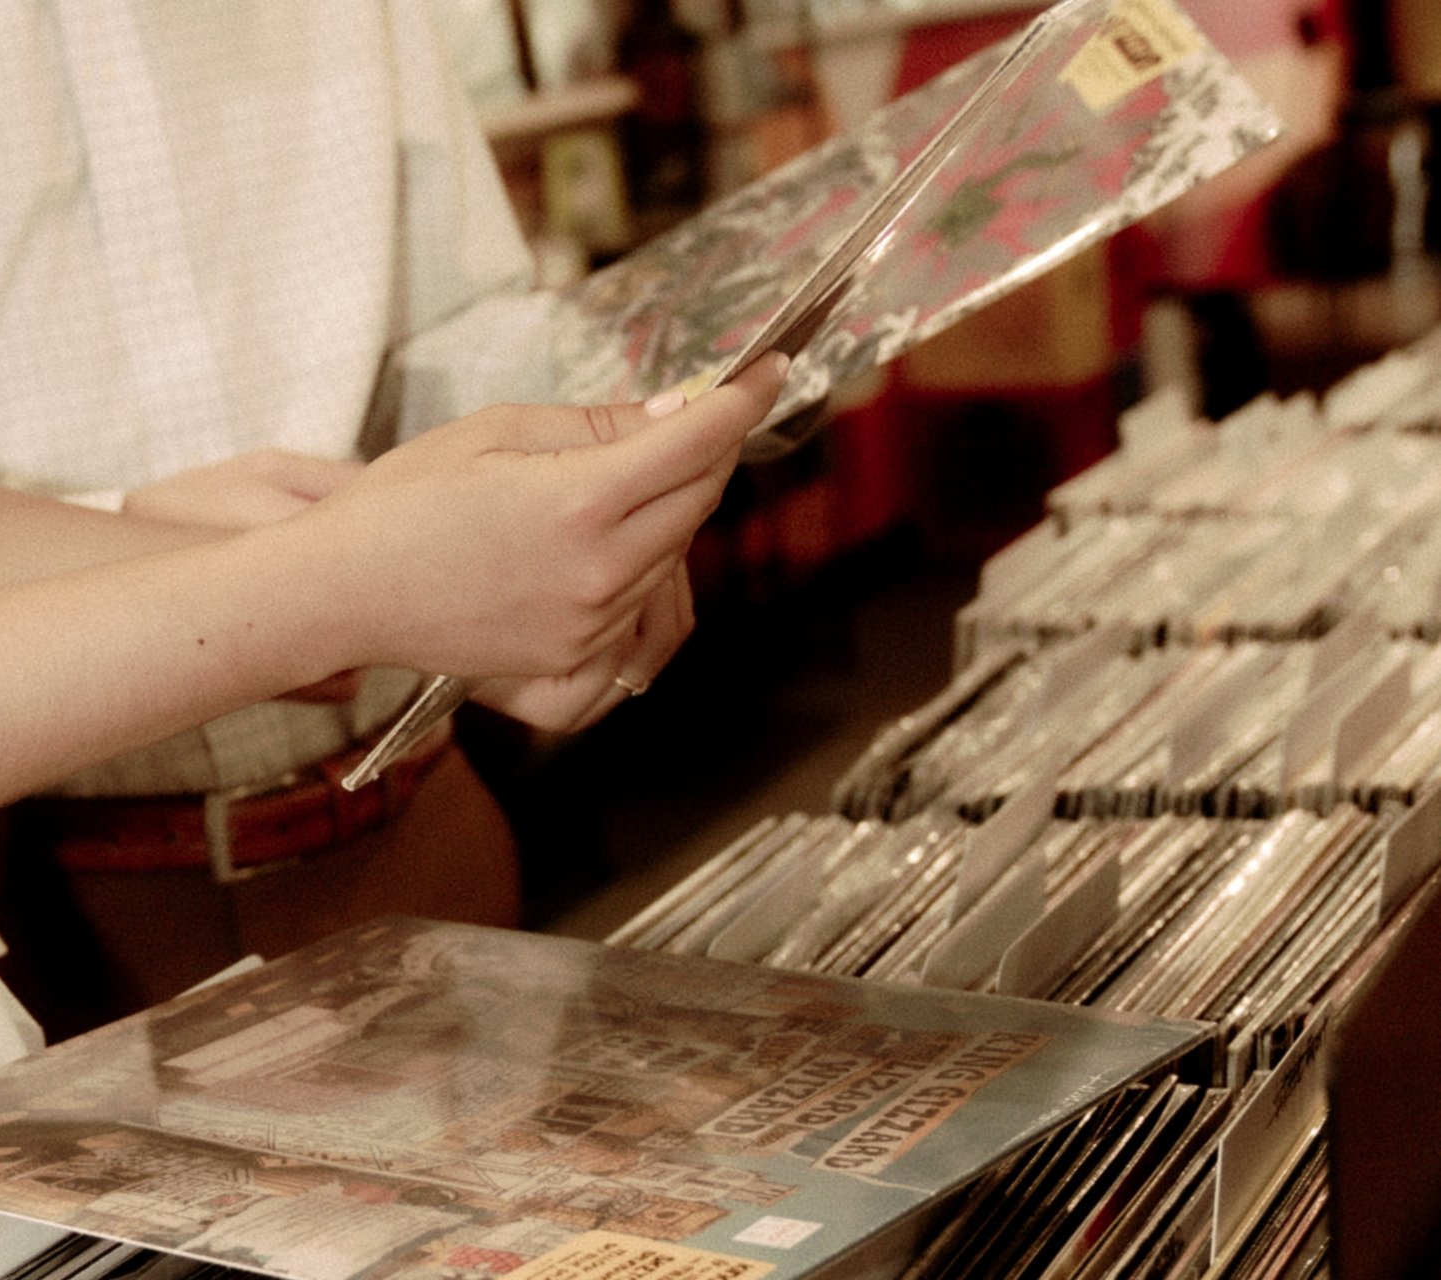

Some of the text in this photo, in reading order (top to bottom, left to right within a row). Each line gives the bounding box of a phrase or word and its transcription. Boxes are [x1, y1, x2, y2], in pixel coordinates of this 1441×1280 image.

[795, 1059, 927, 1124] LIZARD
[933, 1032, 1039, 1081] KING
[713, 1059, 858, 1134] WIZARD
[824, 1086, 967, 1169] GIZZARD
